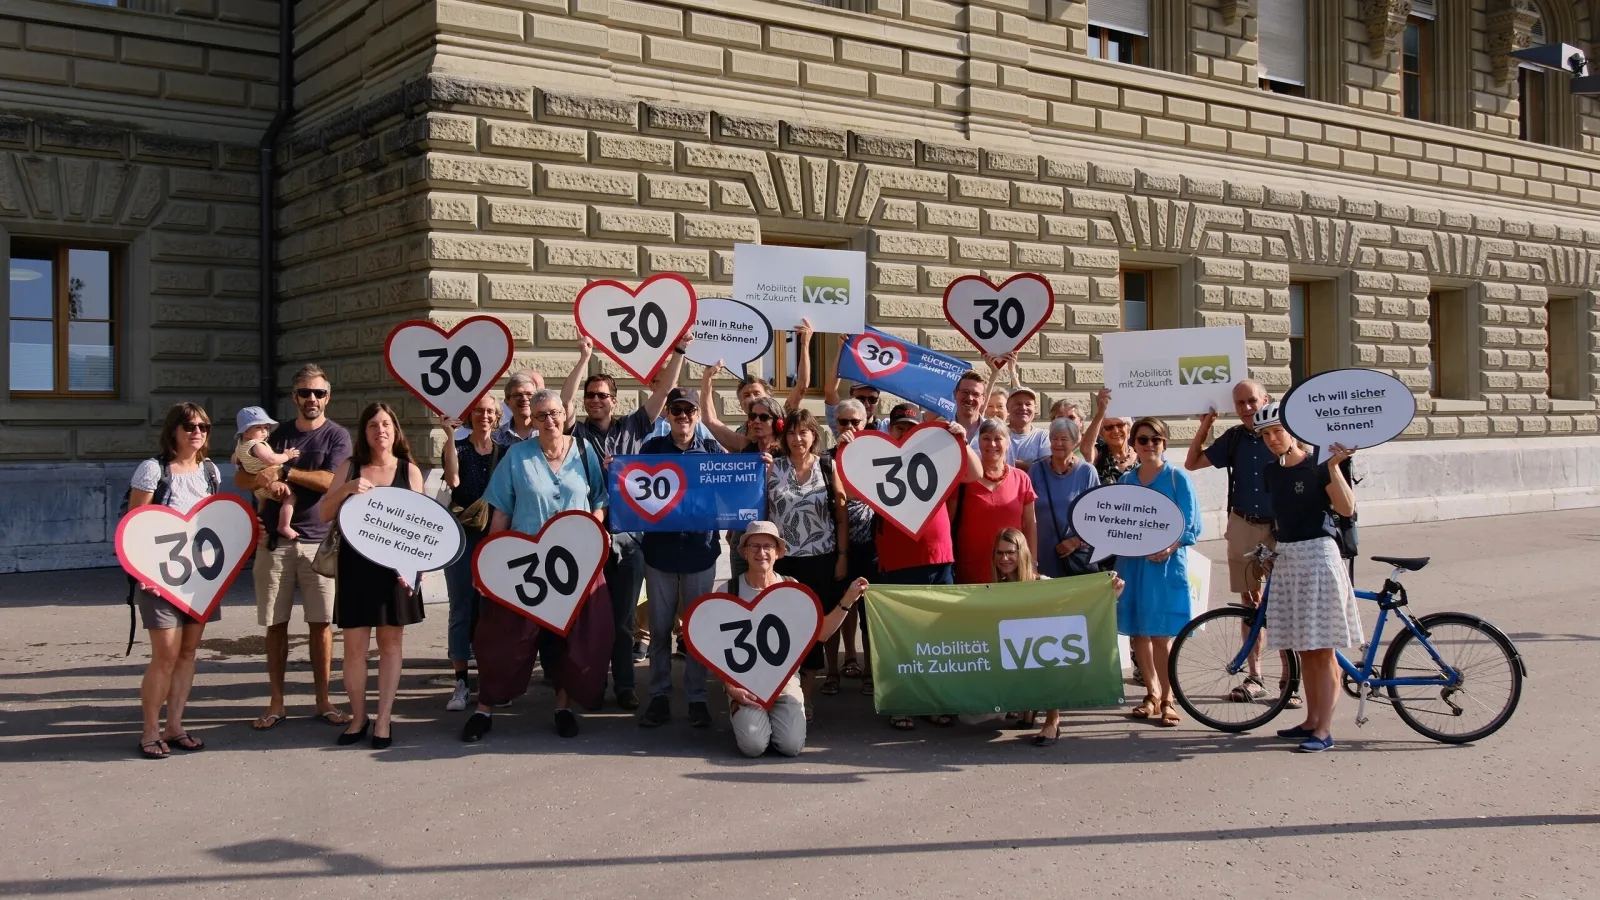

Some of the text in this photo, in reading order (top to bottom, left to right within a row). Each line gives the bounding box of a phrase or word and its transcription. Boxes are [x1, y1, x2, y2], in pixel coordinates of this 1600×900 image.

[757, 284, 797, 293] Mobilität
[805, 286, 847, 305] VCS
[746, 293, 797, 302] mit Zukunft
[702, 319, 717, 327] will
[719, 320, 727, 328] in
[730, 321, 753, 330] Ruhe
[974, 297, 1025, 339] 30
[607, 302, 667, 354] 30
[692, 331, 757, 344] lafen können!
[863, 345, 894, 366] 30
[418, 345, 481, 396] 30
[1130, 369, 1172, 378] Mobilität
[1181, 365, 1229, 384] VCS
[1119, 379, 1173, 389] mit Zukunft
[1308, 389, 1385, 403] Ich will sicher
[1315, 405, 1382, 417] Velo fahren
[1327, 420, 1374, 432] können!
[699, 460, 757, 471] RÜCKSICHT
[700, 473, 757, 483] FÄHRT MIT!
[872, 452, 938, 506] 30
[635, 476, 670, 500] 30
[368, 498, 444, 532] Ich will sichere
[1097, 501, 1157, 514] Ich will mich
[740, 513, 757, 521] VCS
[1084, 513, 1170, 529] im Verkehr sicher
[363, 513, 439, 547] Schulwege für
[1107, 529, 1142, 540] fühlen!
[358, 529, 432, 561] meine Kinder!
[155, 527, 225, 586] 30
[507, 545, 579, 607] 30
[720, 614, 790, 673] 30
[916, 641, 989, 656] Mobilität
[1004, 634, 1086, 669] VCS
[898, 657, 991, 674] mit Zukunft
